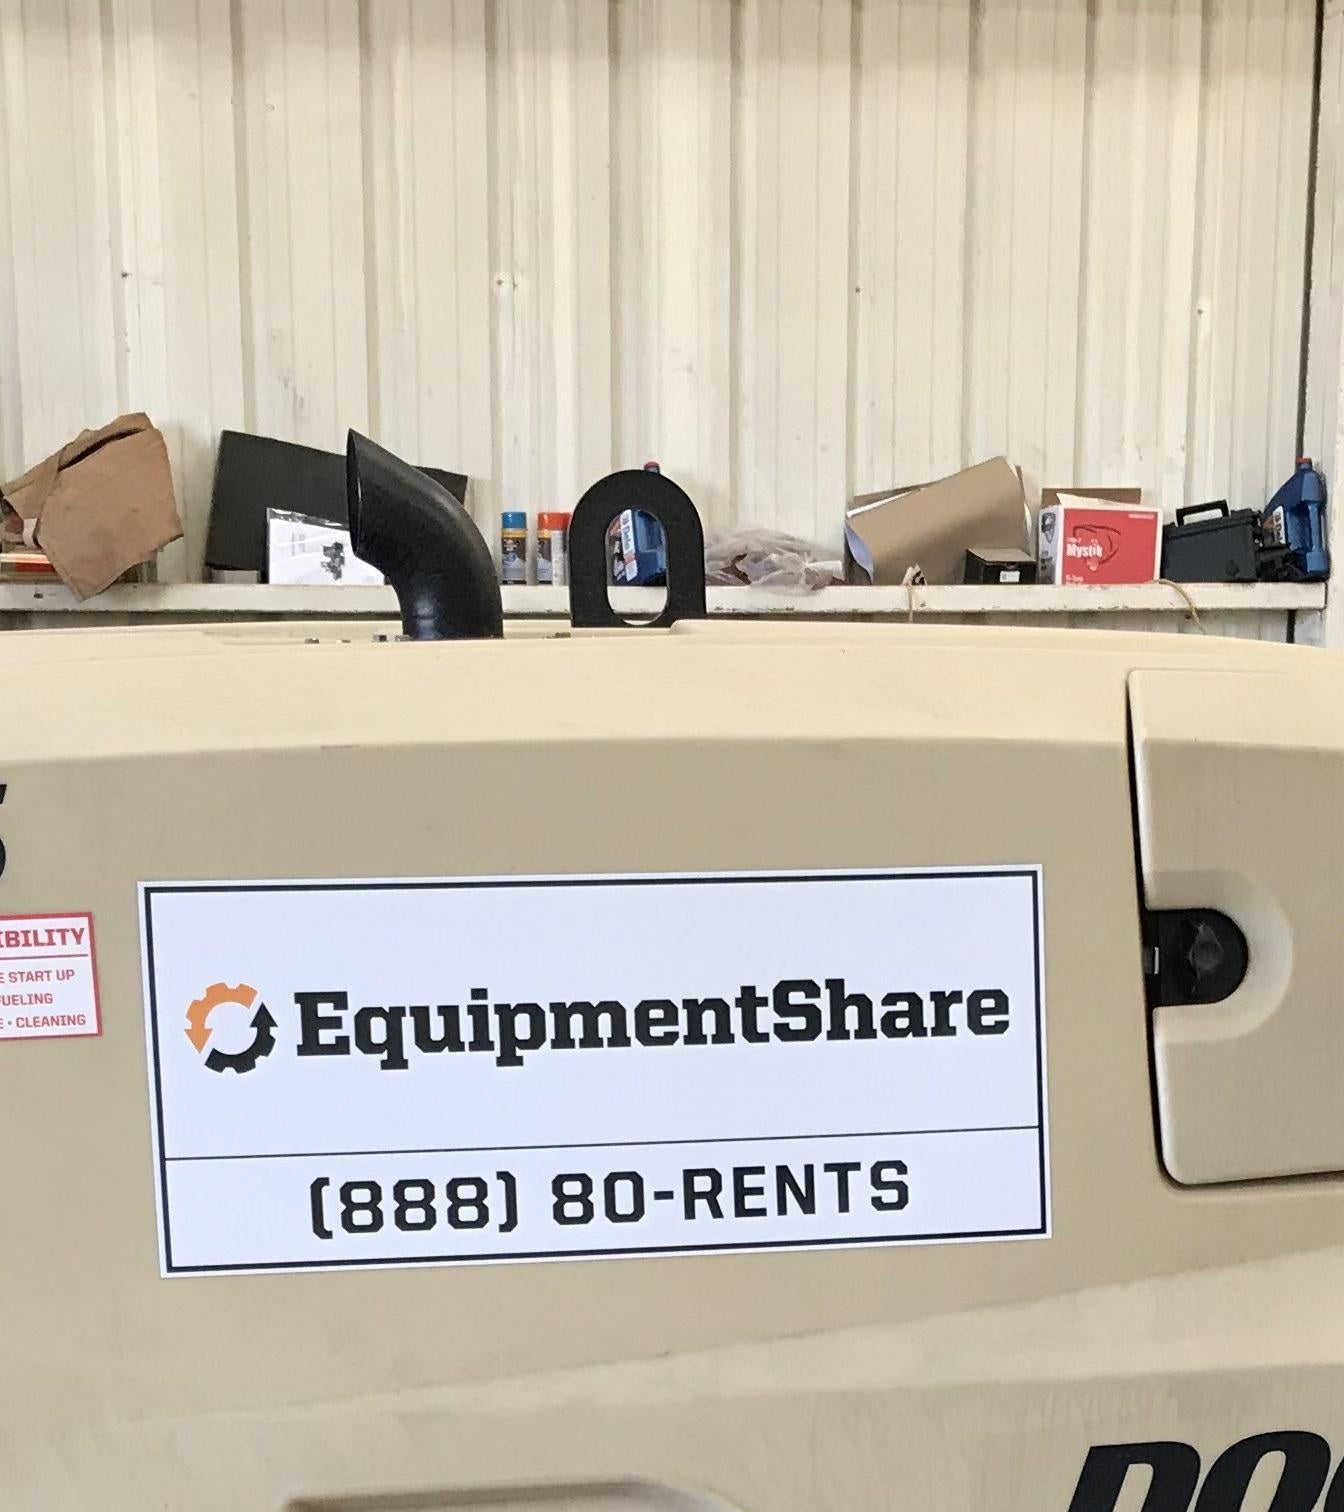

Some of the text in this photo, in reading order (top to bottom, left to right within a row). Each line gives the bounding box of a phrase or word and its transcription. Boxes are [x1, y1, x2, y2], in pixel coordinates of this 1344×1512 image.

[1066, 543, 1103, 558] Mystik
[8, 971, 52, 983] START
[57, 970, 74, 981] UP
[16, 1015, 86, 1028] CLEANING
[293, 978, 1011, 1070] EquipmentShare
[310, 1159, 911, 1240] (888) 80-RENTS
